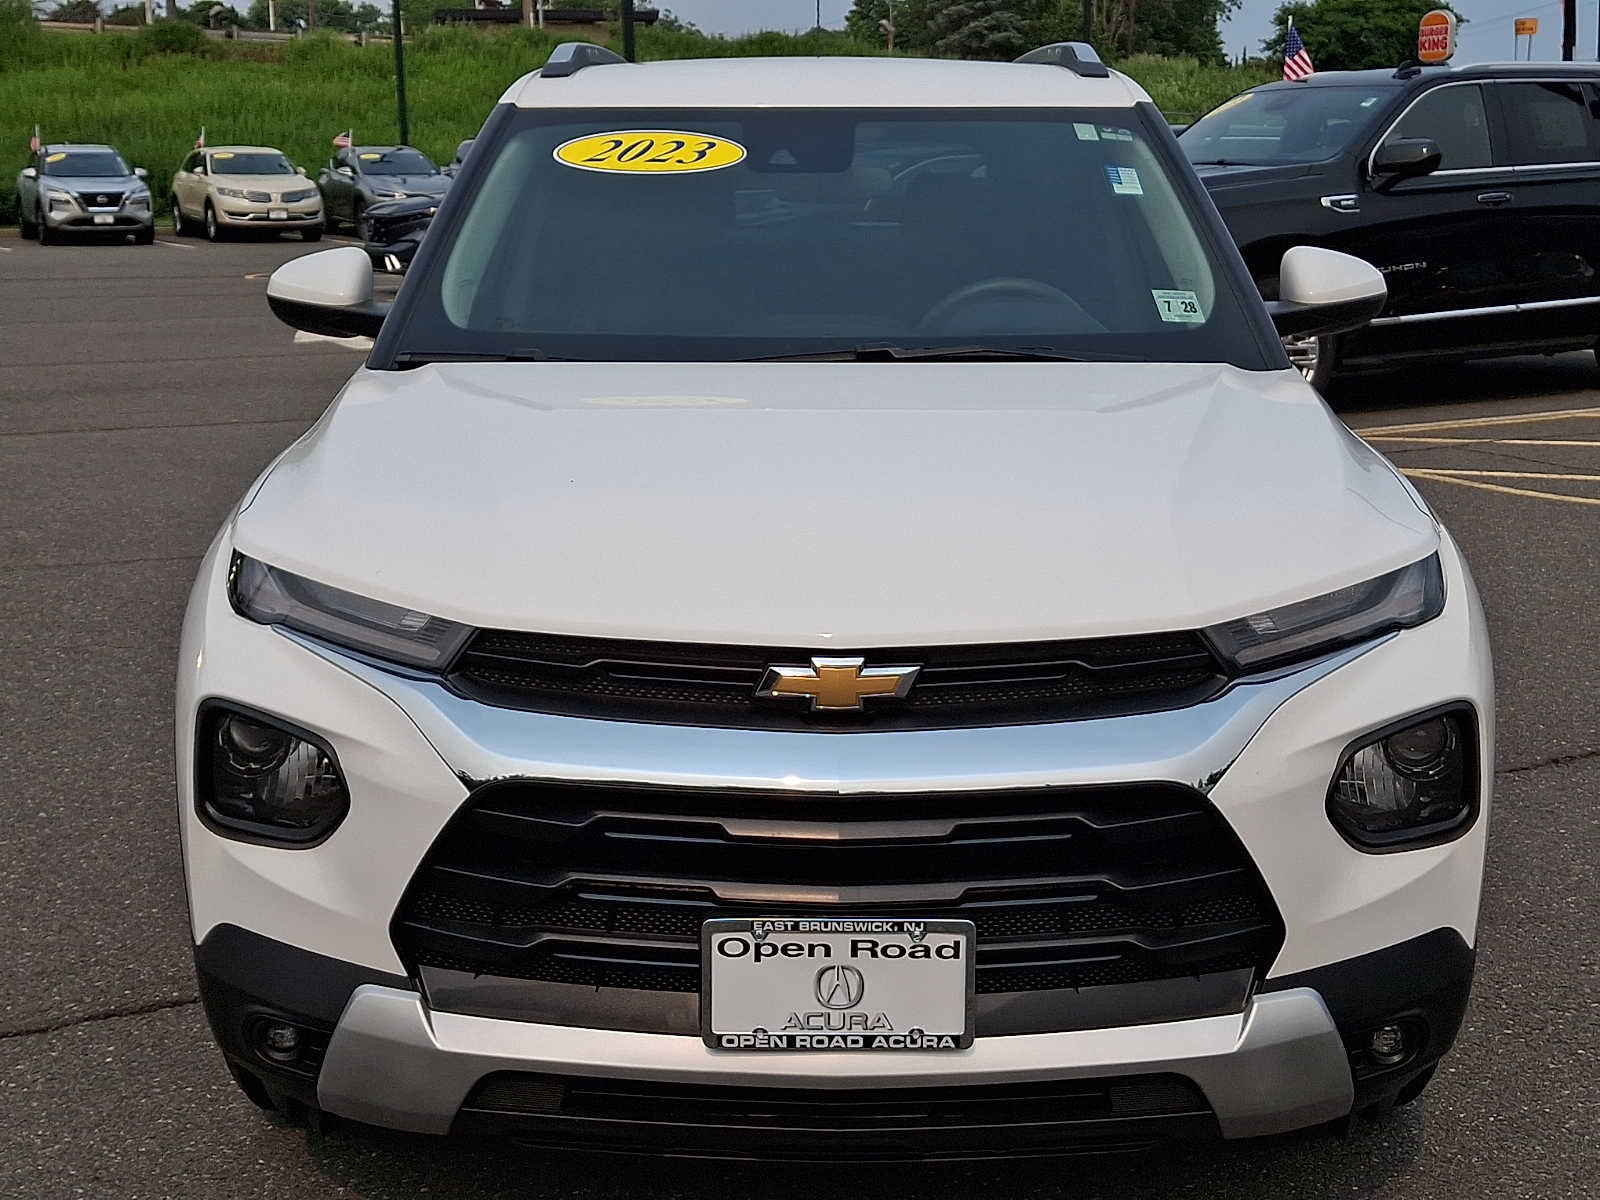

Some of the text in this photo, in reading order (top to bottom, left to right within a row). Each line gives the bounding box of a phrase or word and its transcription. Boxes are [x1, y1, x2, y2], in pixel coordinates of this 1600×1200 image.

[1419, 36, 1448, 51] KING
[581, 139, 717, 164] 2023
[1163, 300, 1198, 313] 7 28
[753, 921, 925, 933] EAST BRUNSWICK, NJ
[717, 937, 961, 962] Open Road
[780, 1011, 894, 1030] ACURA
[721, 1035, 956, 1048] OPEN ROAD ACURA
